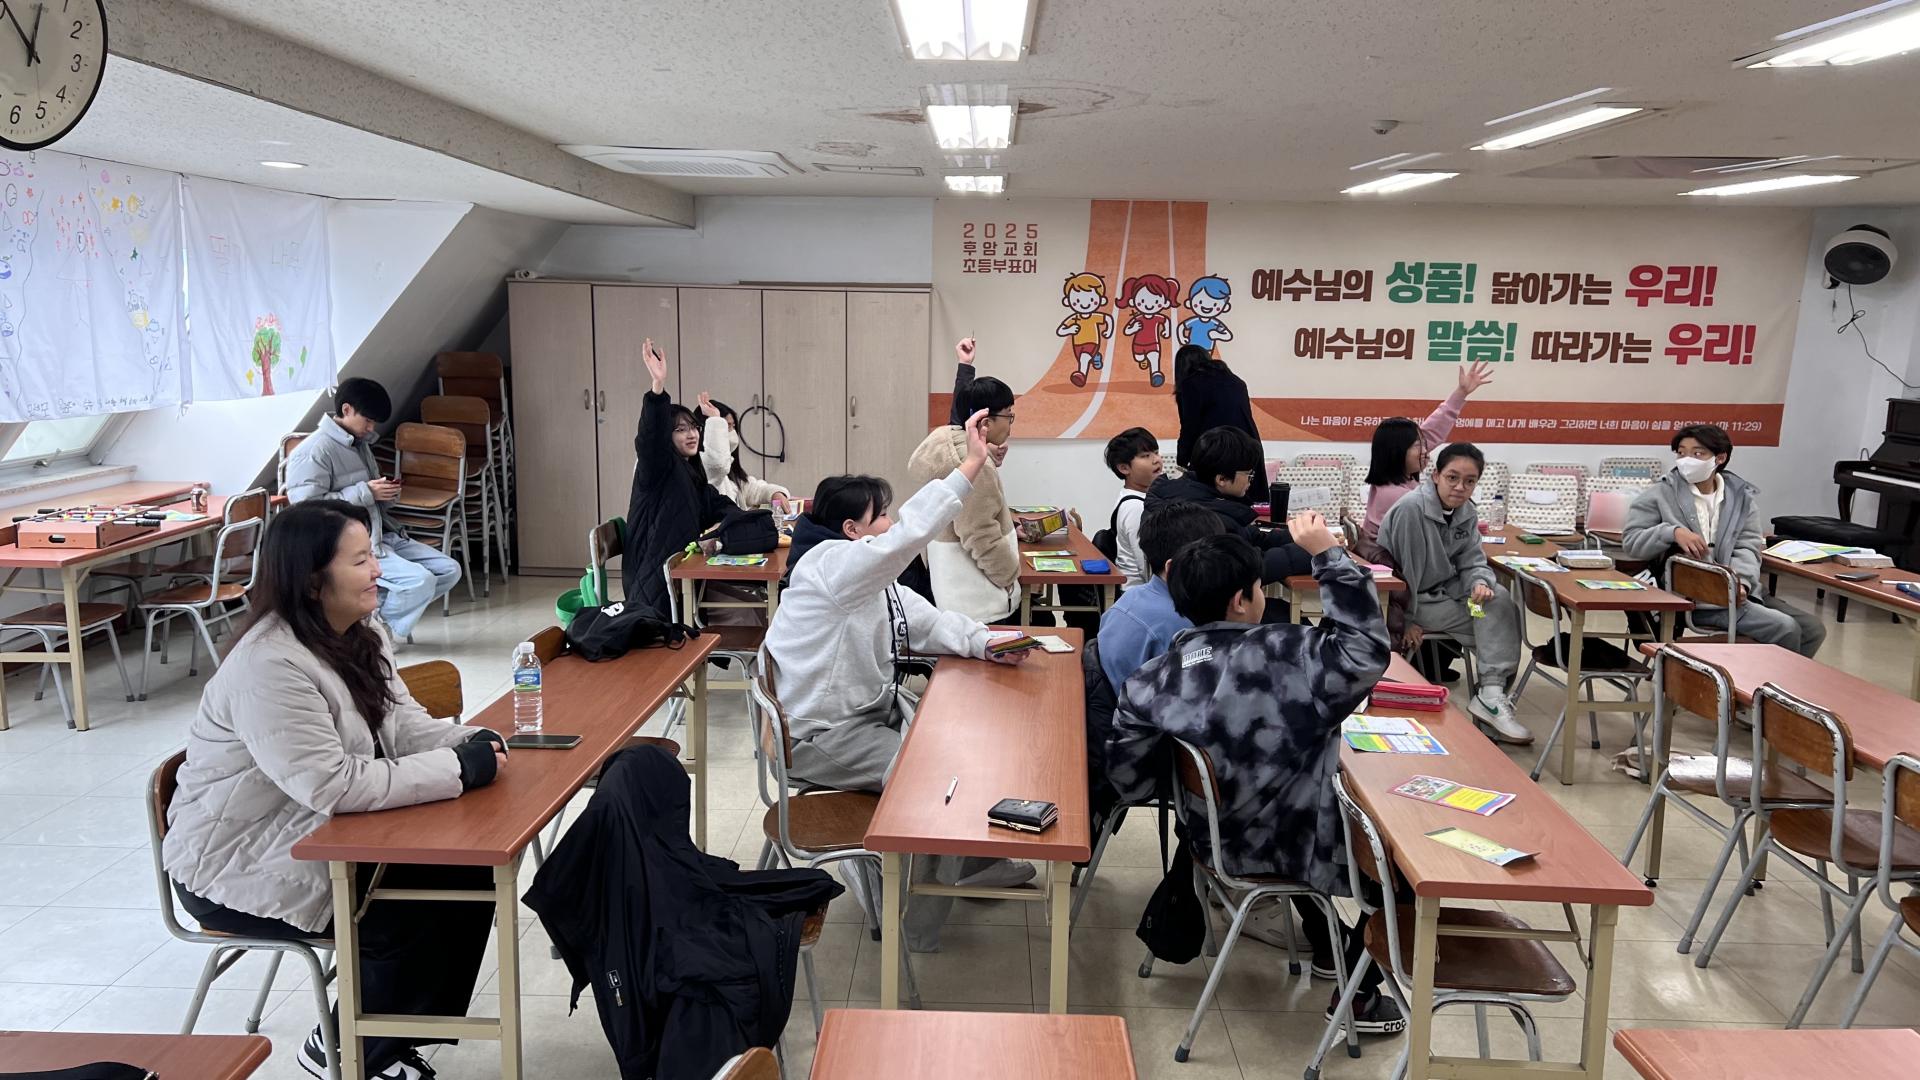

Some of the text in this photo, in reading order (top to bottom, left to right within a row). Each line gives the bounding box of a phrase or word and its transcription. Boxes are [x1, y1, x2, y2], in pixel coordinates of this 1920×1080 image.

[69, 20, 83, 40] 2
[70, 53, 82, 73] 3
[55, 84, 67, 104] 4
[9, 104, 22, 125] 6
[35, 100, 48, 120] 5
[963, 222, 1039, 239] 2025
[963, 240, 1038, 257] 후암교회
[962, 258, 1037, 274] 초등부표어
[1251, 261, 1718, 307] 예수님의 성품! 닮아가는 우리!
[1293, 320, 1757, 365] 예수님의 말씀! 따라가는 우리!
[1300, 415, 1391, 427] 나는 마음이 온유하
[1486, 418, 1505, 429] 메고
[1507, 418, 1527, 429] 내게
[1528, 418, 1557, 429] 배우라
[1600, 419, 1619, 430] 너희
[1620, 420, 1649, 430] 마음이
[1732, 421, 1762, 432] 11:29)
